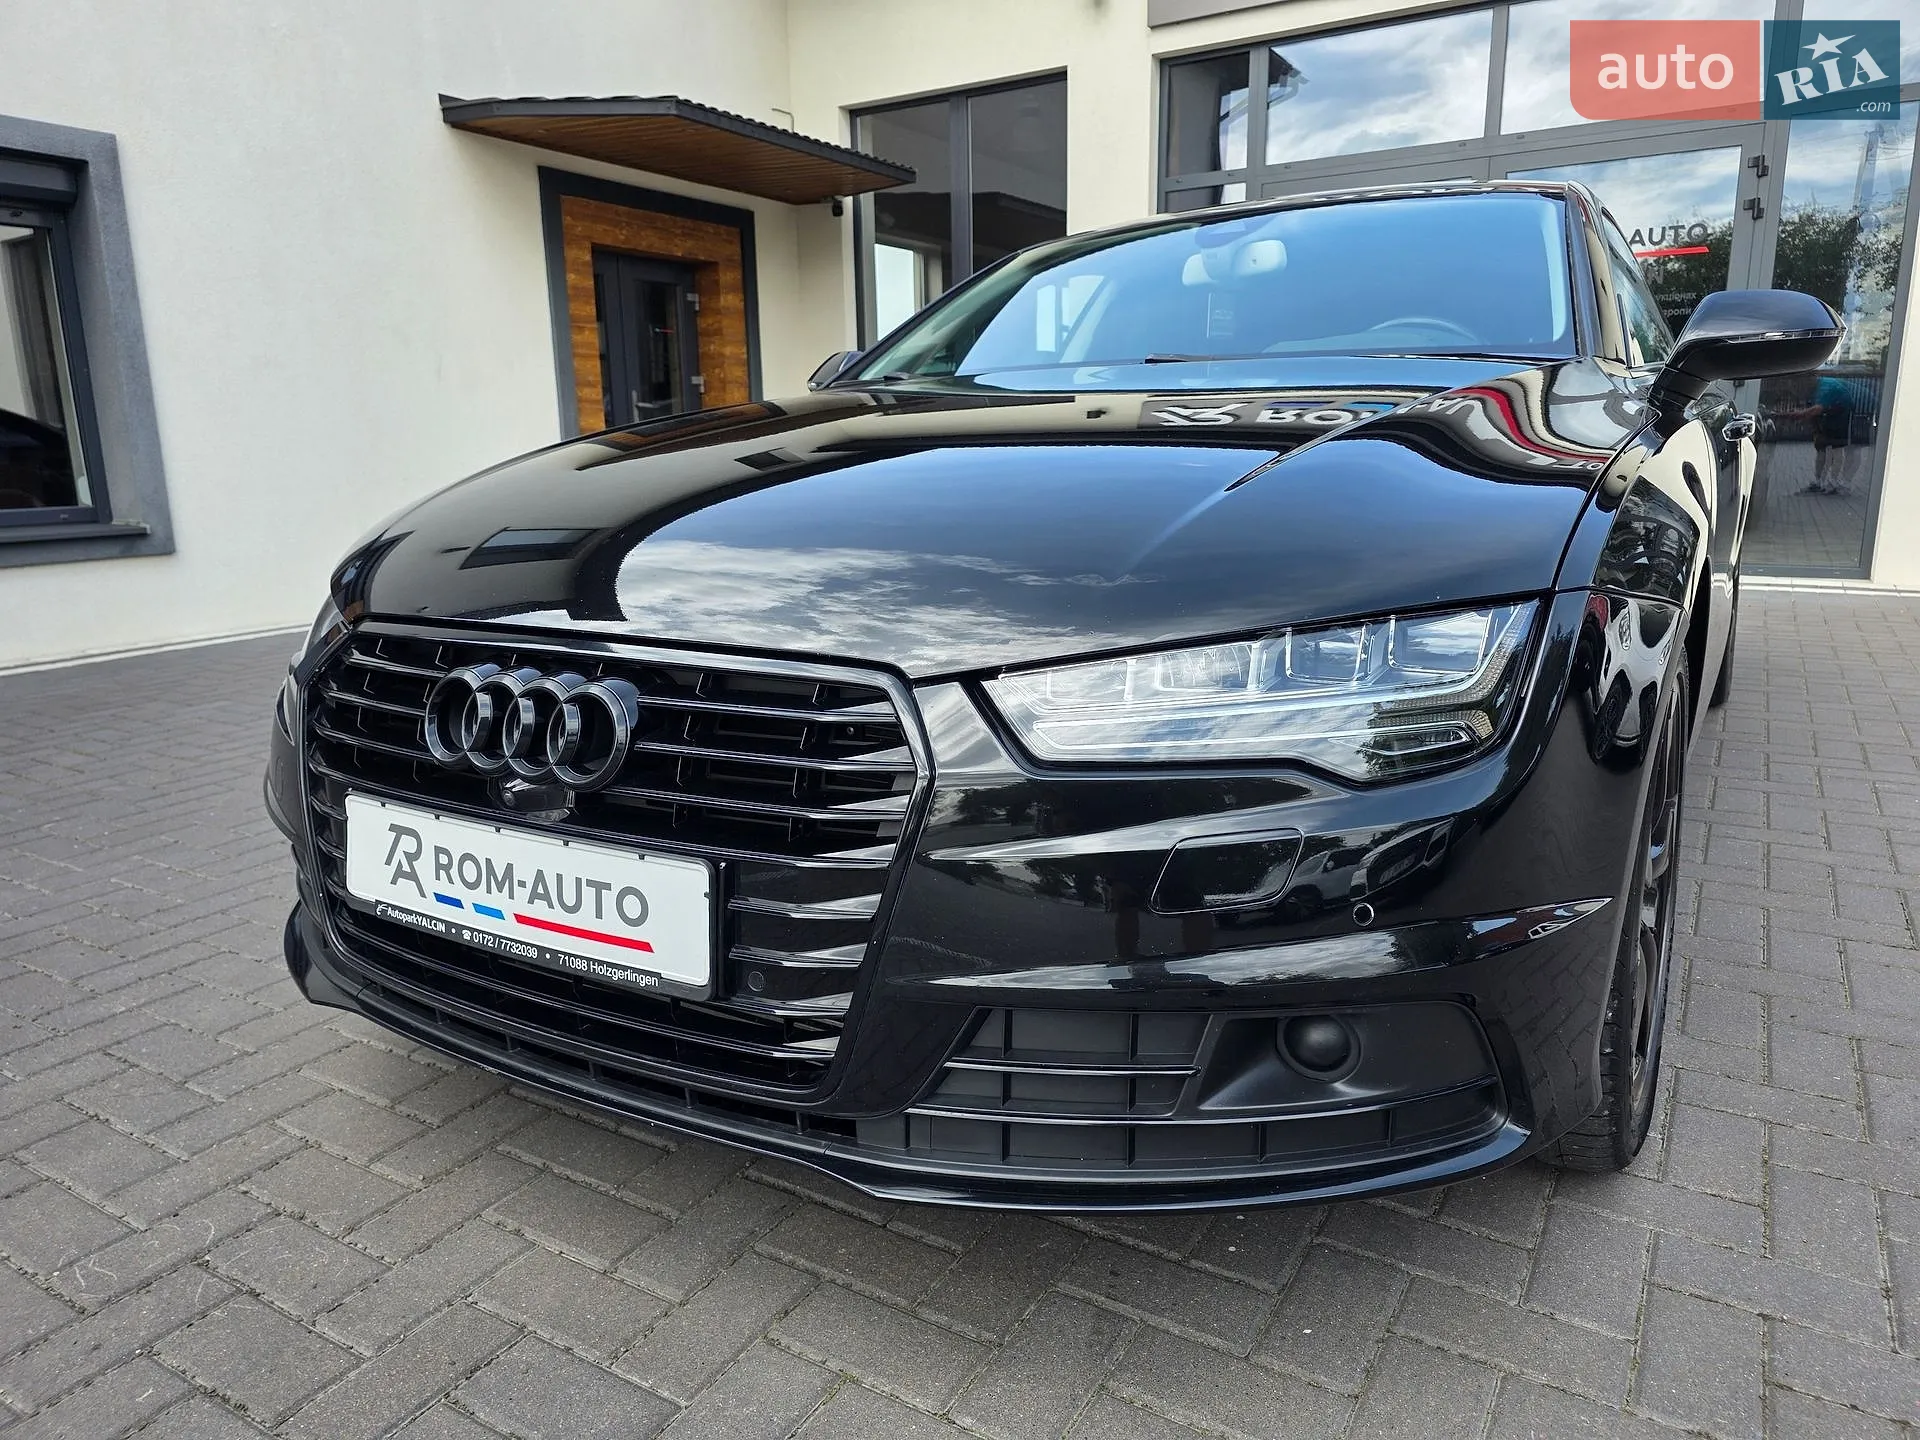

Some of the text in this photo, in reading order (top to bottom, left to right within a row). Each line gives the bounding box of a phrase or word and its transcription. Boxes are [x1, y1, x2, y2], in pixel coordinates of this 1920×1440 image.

[1629, 223, 1708, 247] AUTO
[434, 845, 650, 928] ROM-AUTO
[387, 906, 446, 933] AutoparkYALCIN
[473, 931, 494, 948] 0172
[500, 938, 538, 959] 7732039
[558, 953, 588, 972] 71088
[590, 961, 659, 987] Holzgerlingen
